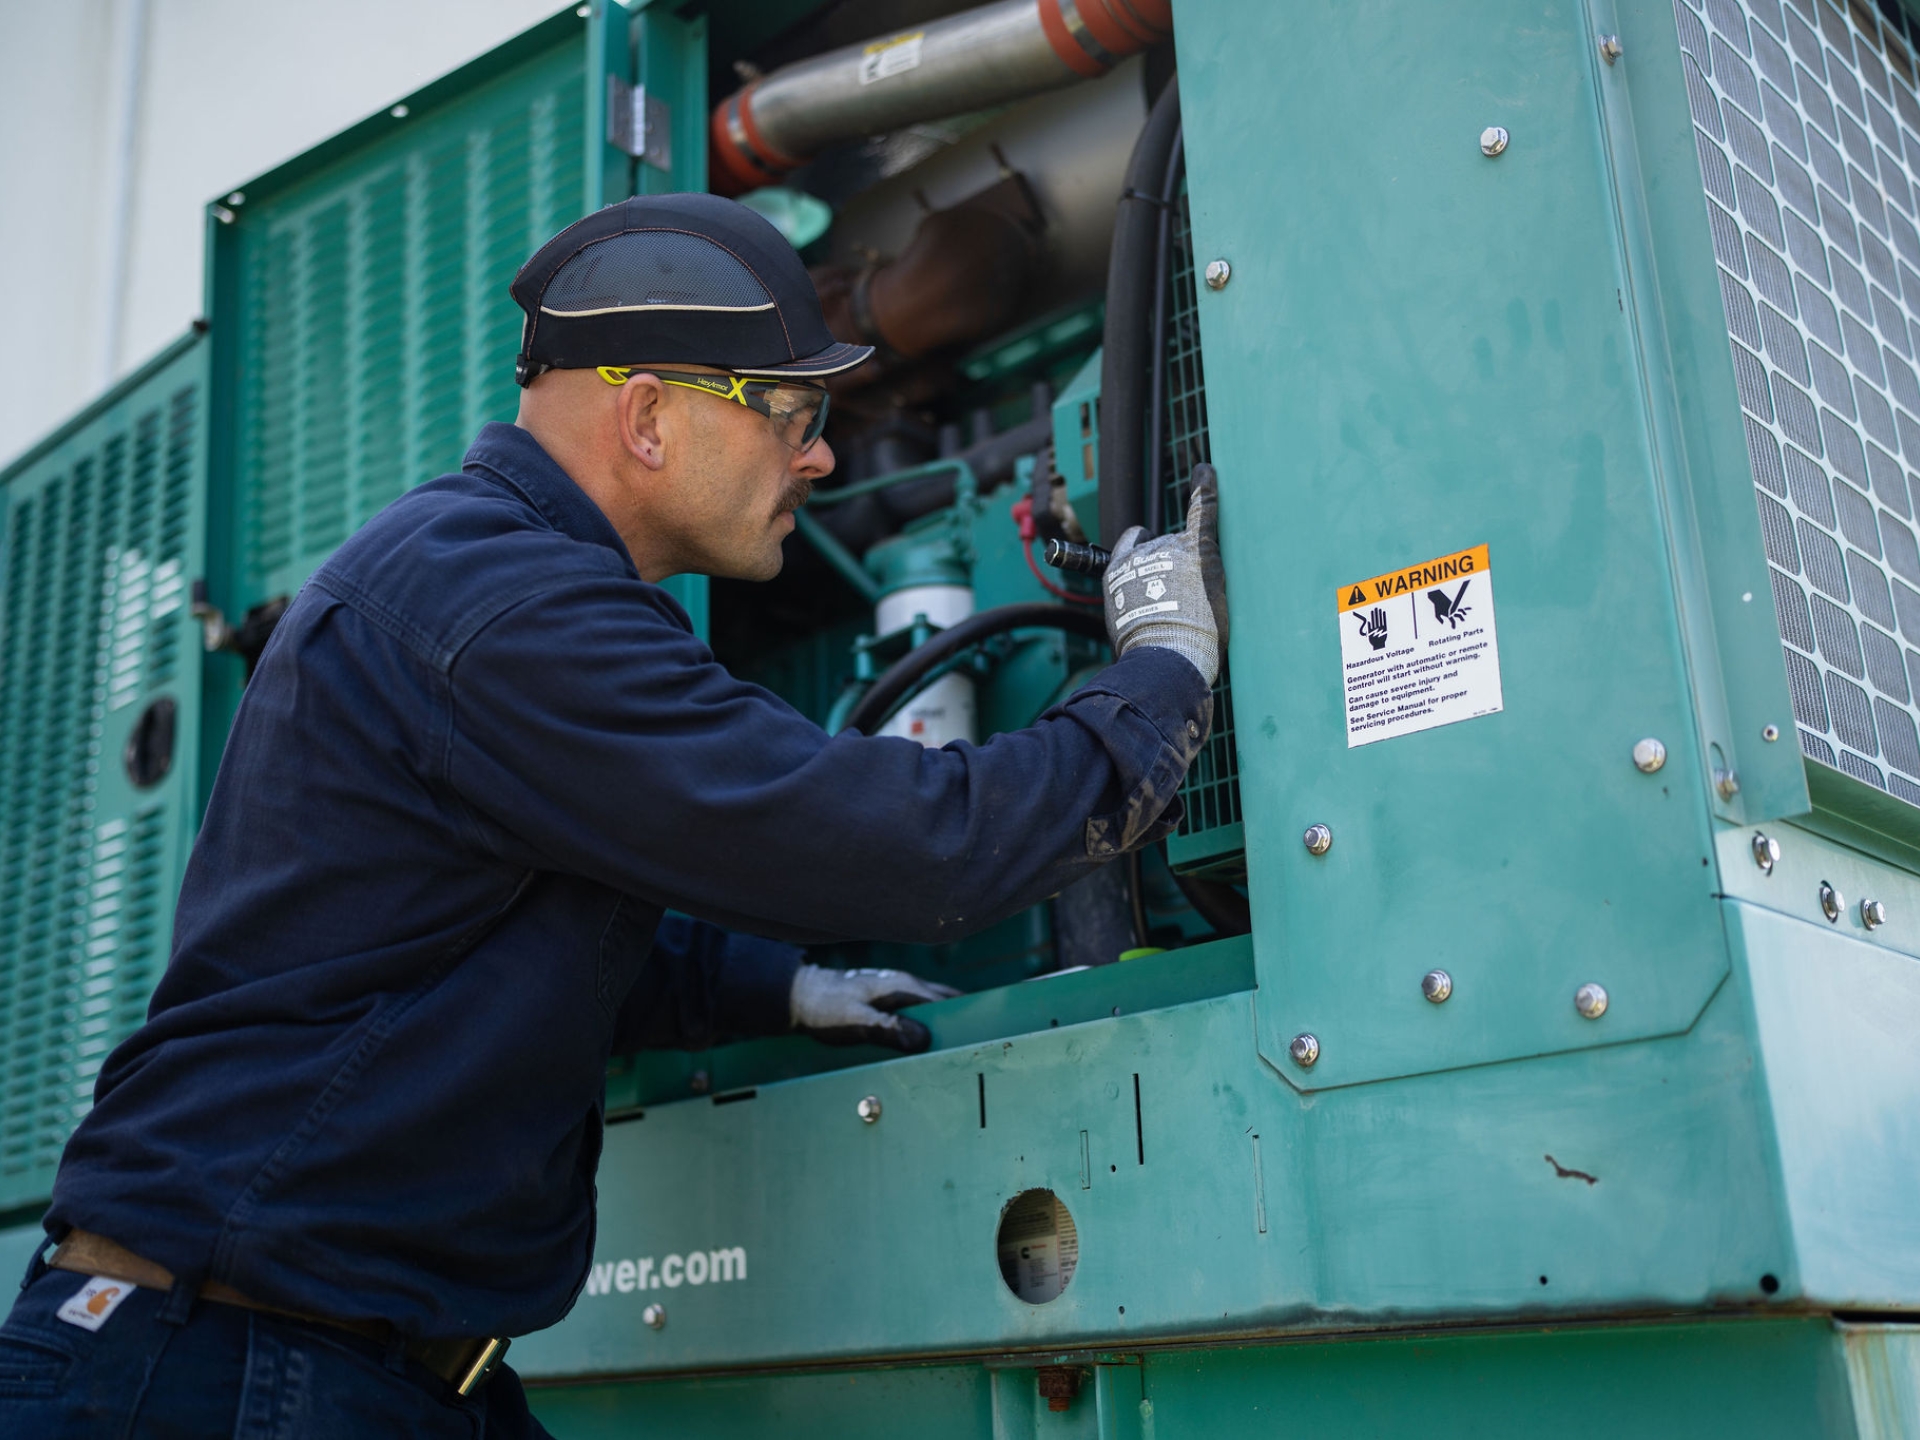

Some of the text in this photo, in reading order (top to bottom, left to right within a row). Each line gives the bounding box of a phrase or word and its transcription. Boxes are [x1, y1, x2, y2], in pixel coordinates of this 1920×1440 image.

[1375, 555, 1474, 597] WARNING
[1429, 627, 1484, 647] Rotating Parts
[1347, 646, 1414, 669] Hazardous Voltage
[1348, 668, 1385, 684] Generator
[1387, 664, 1404, 675] with
[1406, 653, 1446, 668] automatic
[1459, 641, 1488, 654] remote
[1348, 653, 1480, 691] control will start without warning.
[1349, 670, 1458, 704] Can cause severe injury and
[1349, 699, 1379, 712] damage
[1392, 686, 1435, 701] equipment.
[1350, 689, 1468, 724] See Service Manual for proper
[1351, 708, 1434, 732] servicing procedures.
[586, 1246, 747, 1296] wer.com
